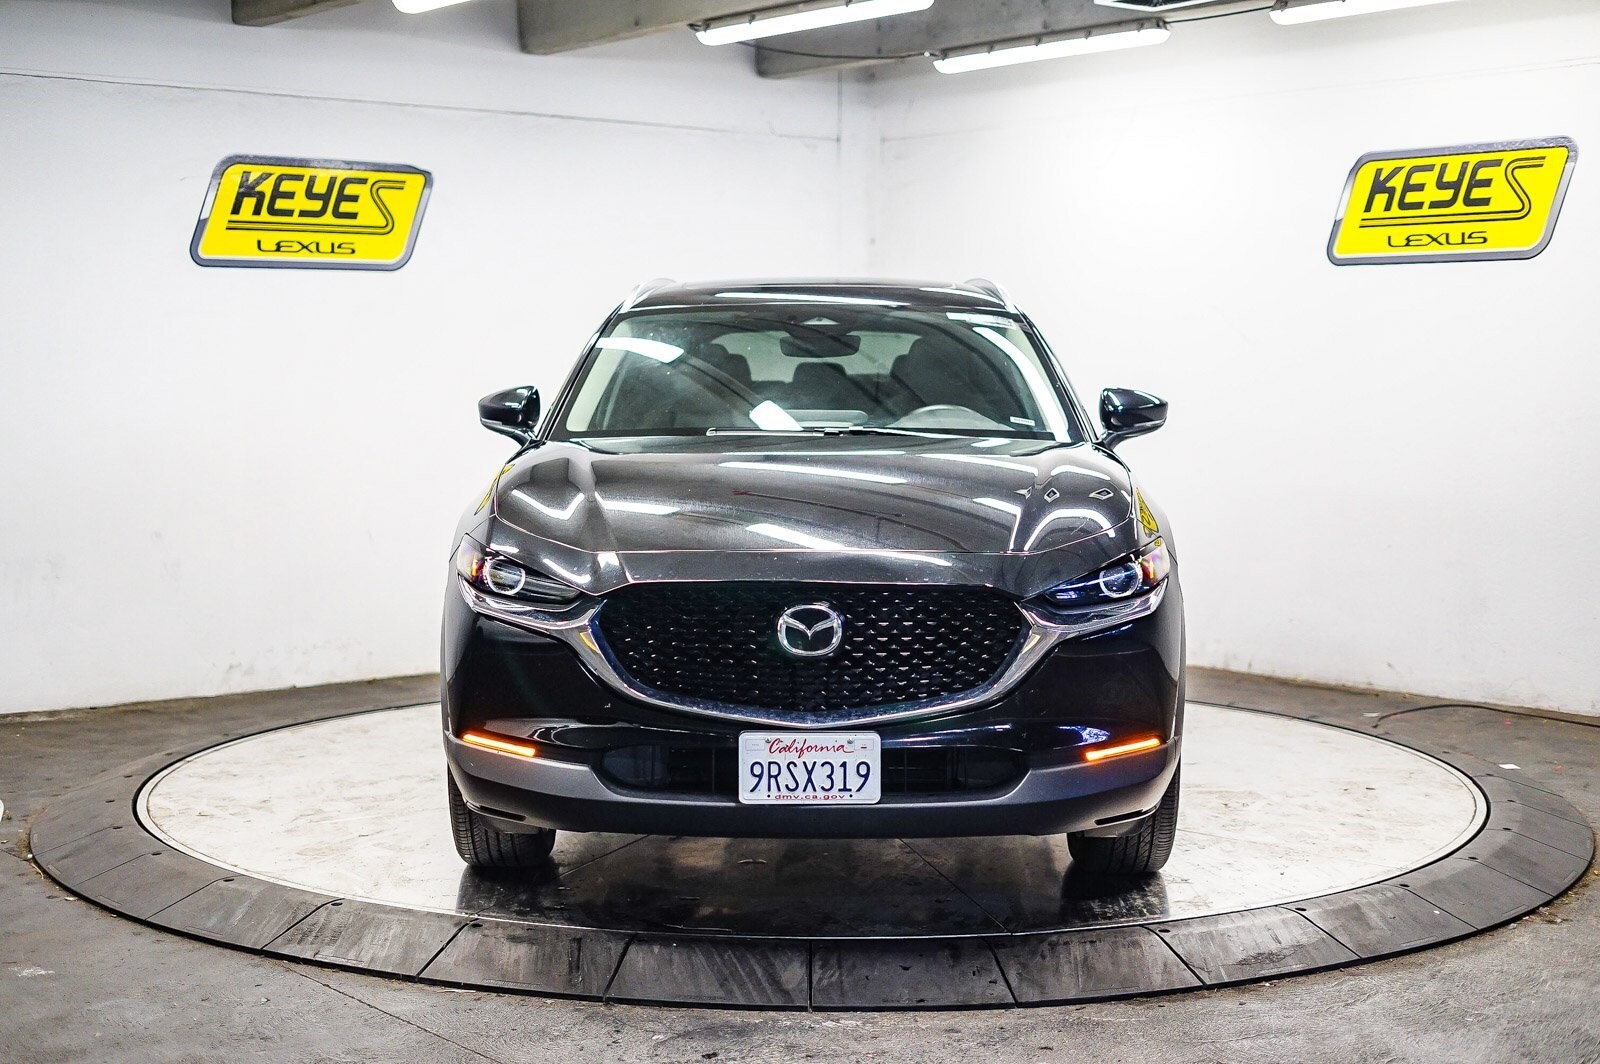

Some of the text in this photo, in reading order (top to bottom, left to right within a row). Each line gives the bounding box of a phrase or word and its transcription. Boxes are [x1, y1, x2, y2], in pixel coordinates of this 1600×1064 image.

[226, 171, 406, 235] KEYES
[1359, 156, 1547, 228] KEYES
[257, 239, 356, 255] LEXUS
[1387, 231, 1487, 248] LEXUS
[768, 738, 854, 759] California
[749, 761, 871, 792] 9RSX319
